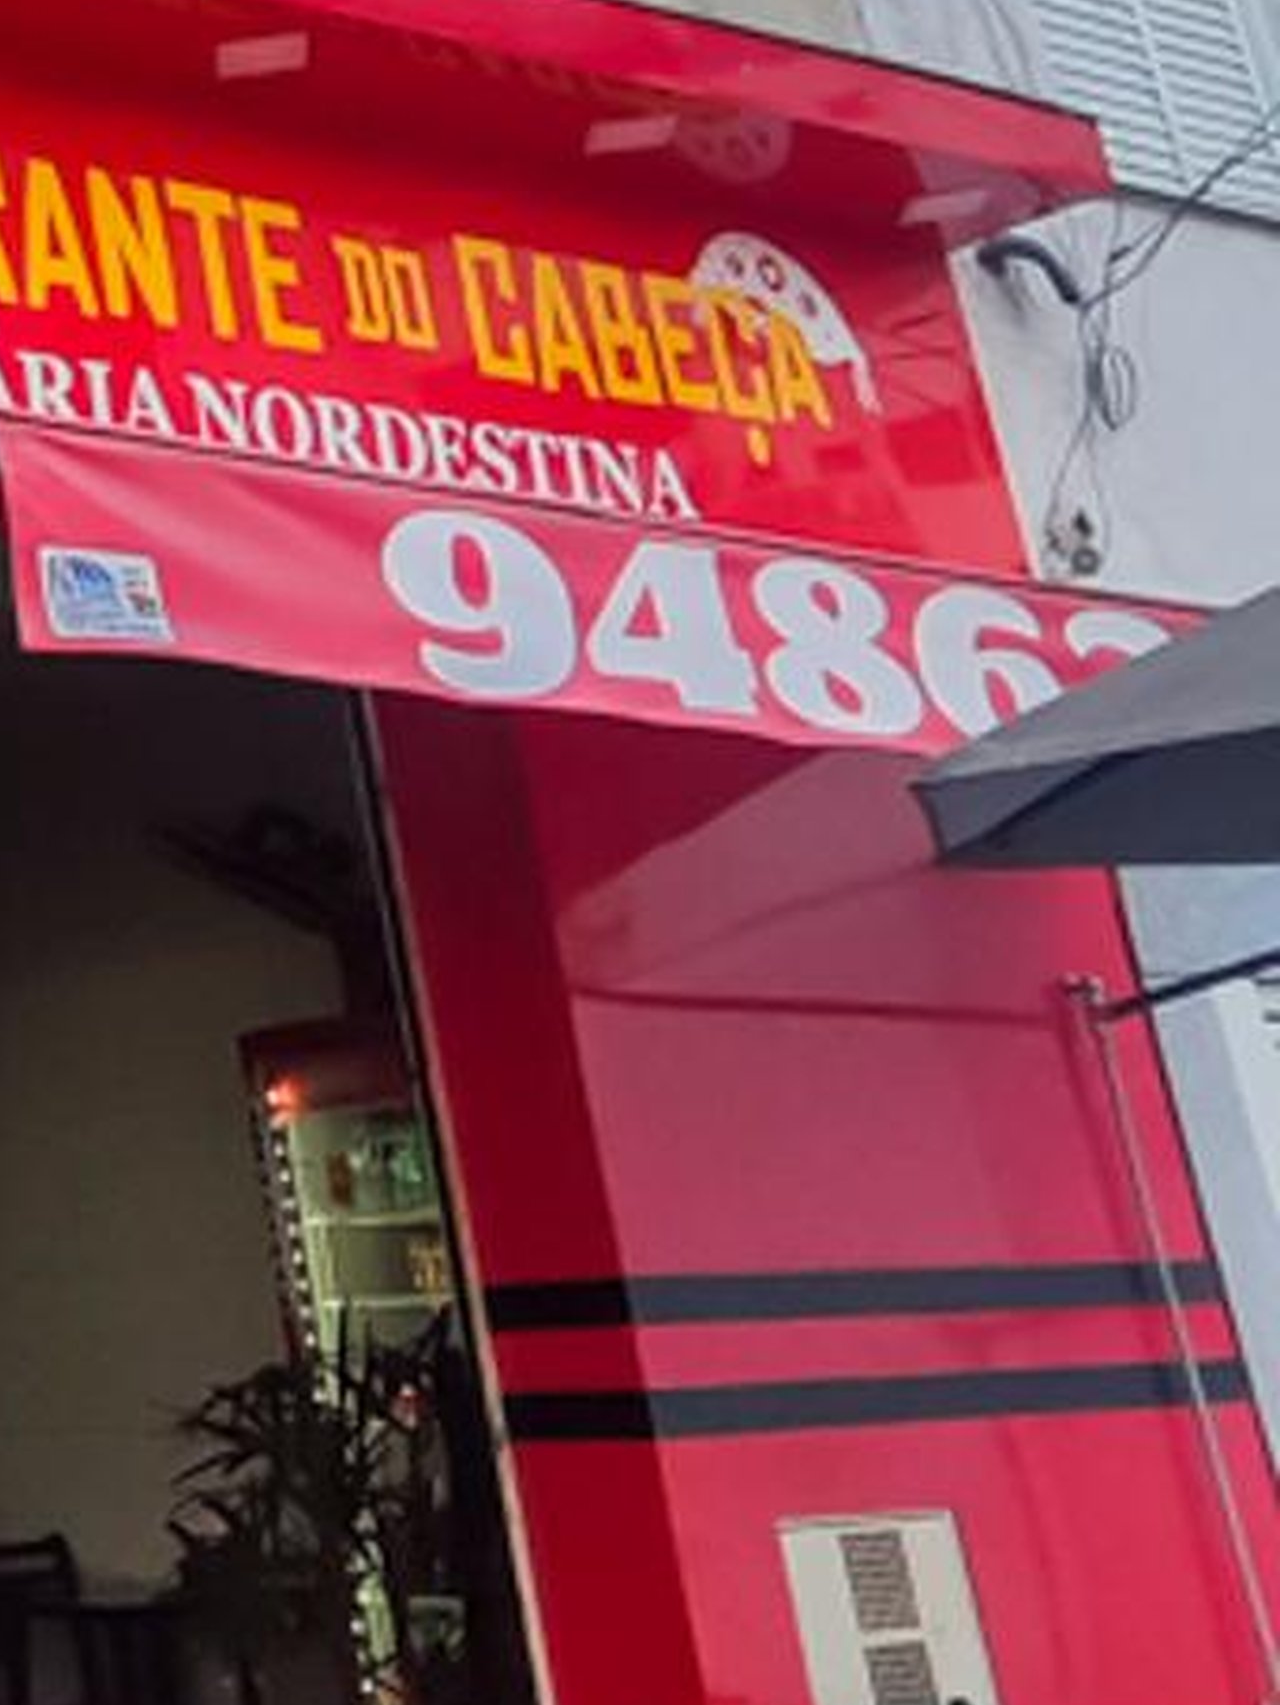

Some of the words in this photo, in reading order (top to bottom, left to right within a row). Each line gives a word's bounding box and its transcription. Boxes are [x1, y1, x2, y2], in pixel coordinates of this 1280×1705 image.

[331, 238, 437, 351] DO
[452, 233, 833, 467] CABEÇA
[185, 375, 701, 523] NORDESTINA
